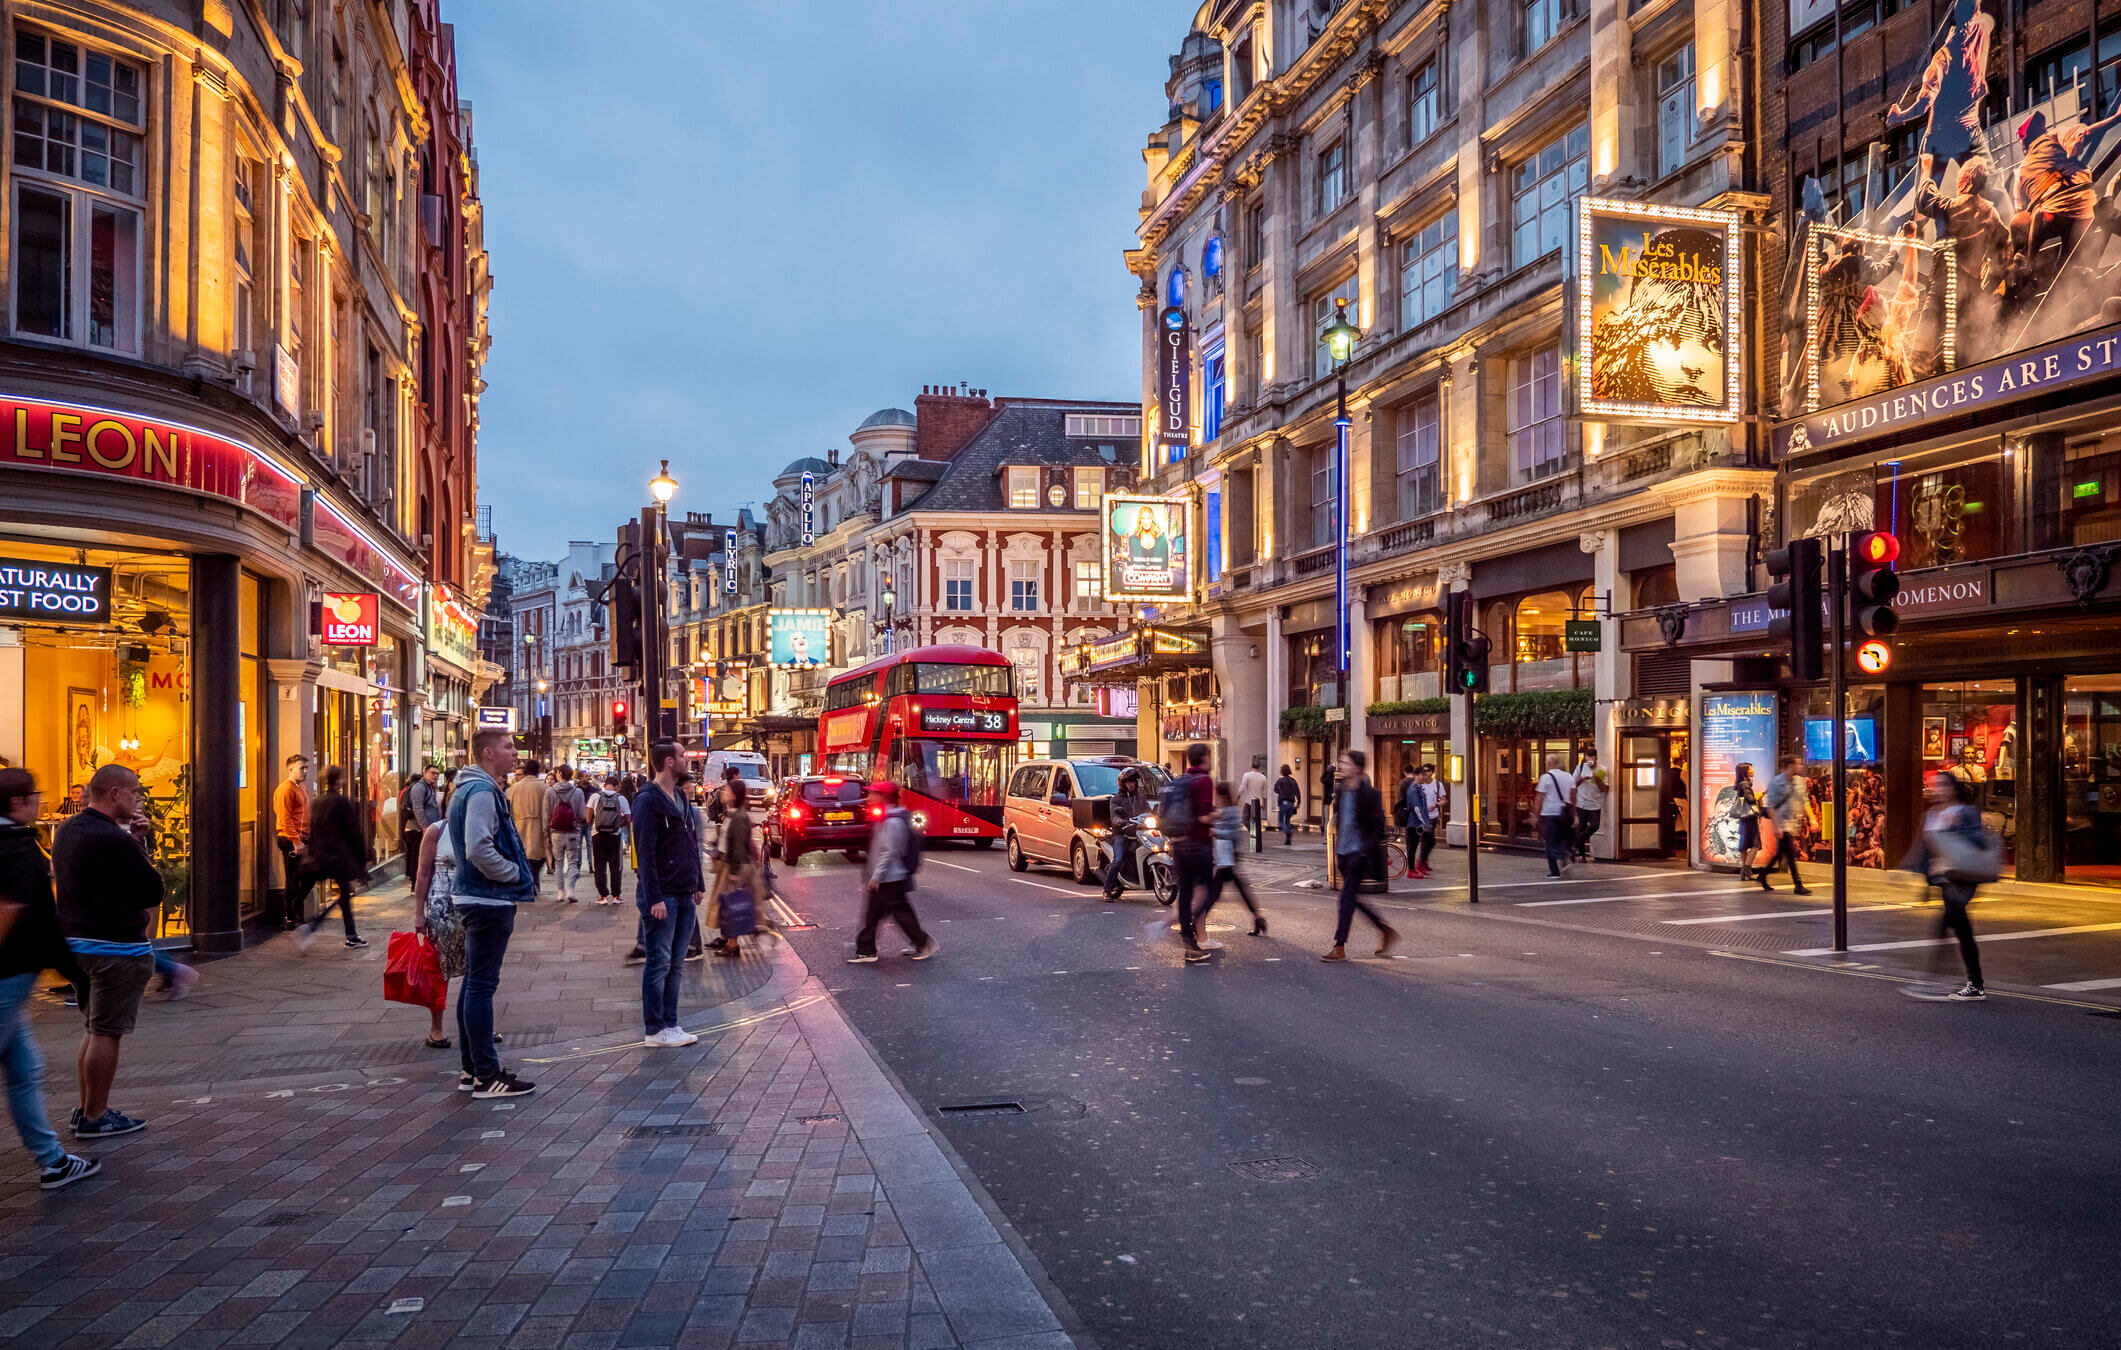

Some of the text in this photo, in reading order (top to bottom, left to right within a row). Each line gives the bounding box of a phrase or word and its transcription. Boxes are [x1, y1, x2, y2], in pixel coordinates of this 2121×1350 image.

[1642, 232, 1675, 258] Les
[1599, 244, 1721, 285] Misérables
[1168, 332, 1182, 430] GIELGUD
[1997, 355, 2062, 393] ARE
[15, 407, 179, 479] LEON
[803, 482, 813, 543] APOLLO
[727, 539, 736, 590] LYRIC
[31, 592, 99, 612] FOOD
[1890, 580, 1982, 607] OMENON
[773, 618, 825, 632] JAMIE
[1732, 610, 1761, 626] THE
[328, 624, 372, 639] LEON
[695, 702, 742, 712] THRILLER
[1703, 704, 1716, 716] Les
[925, 714, 1001, 729] Hackney Central 38
[1402, 719, 1439, 729] MONICO
